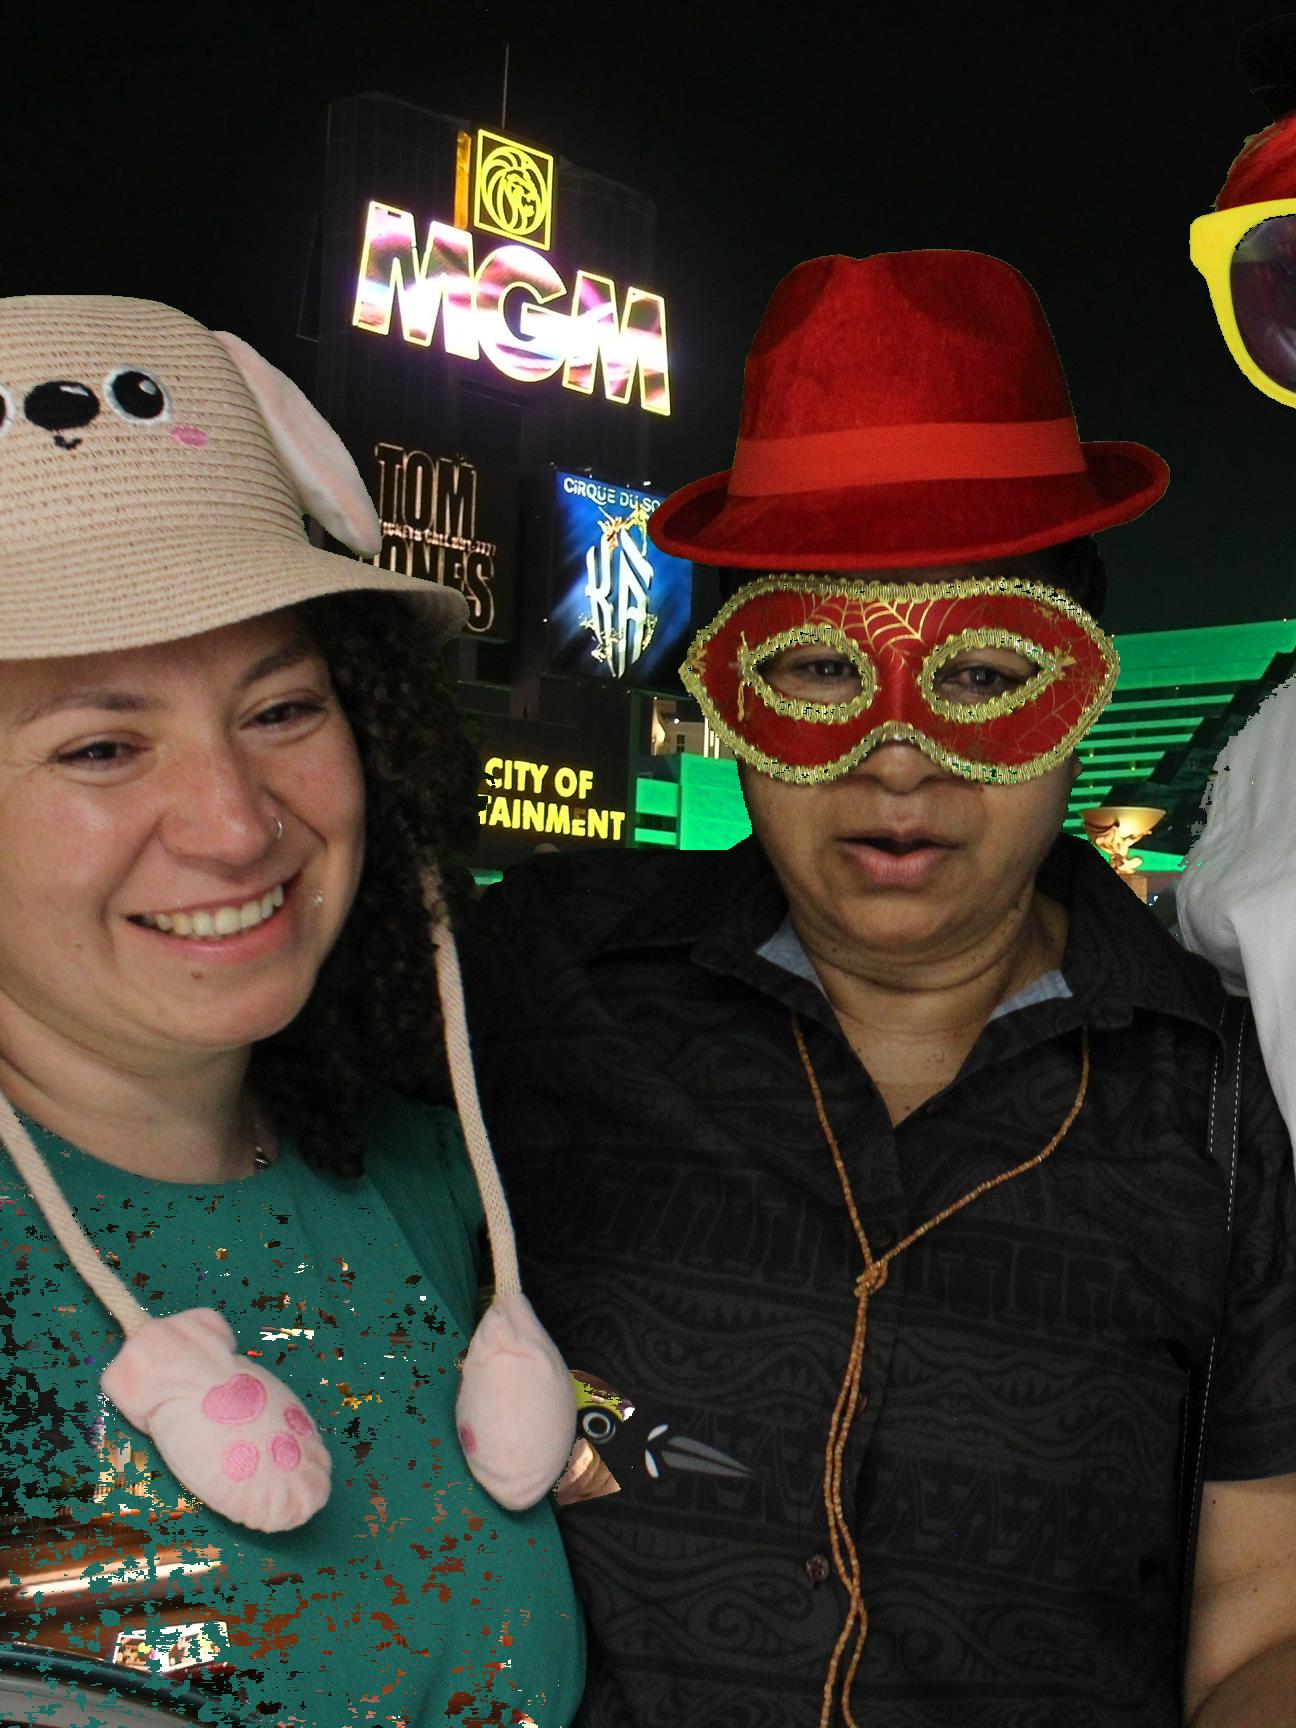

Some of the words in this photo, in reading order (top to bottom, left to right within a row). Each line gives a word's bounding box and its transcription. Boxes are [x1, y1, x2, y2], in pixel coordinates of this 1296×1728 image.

[352, 201, 671, 416] MGM
[375, 442, 477, 541] TOM
[484, 757, 549, 794] CITY
[554, 767, 594, 799] OF
